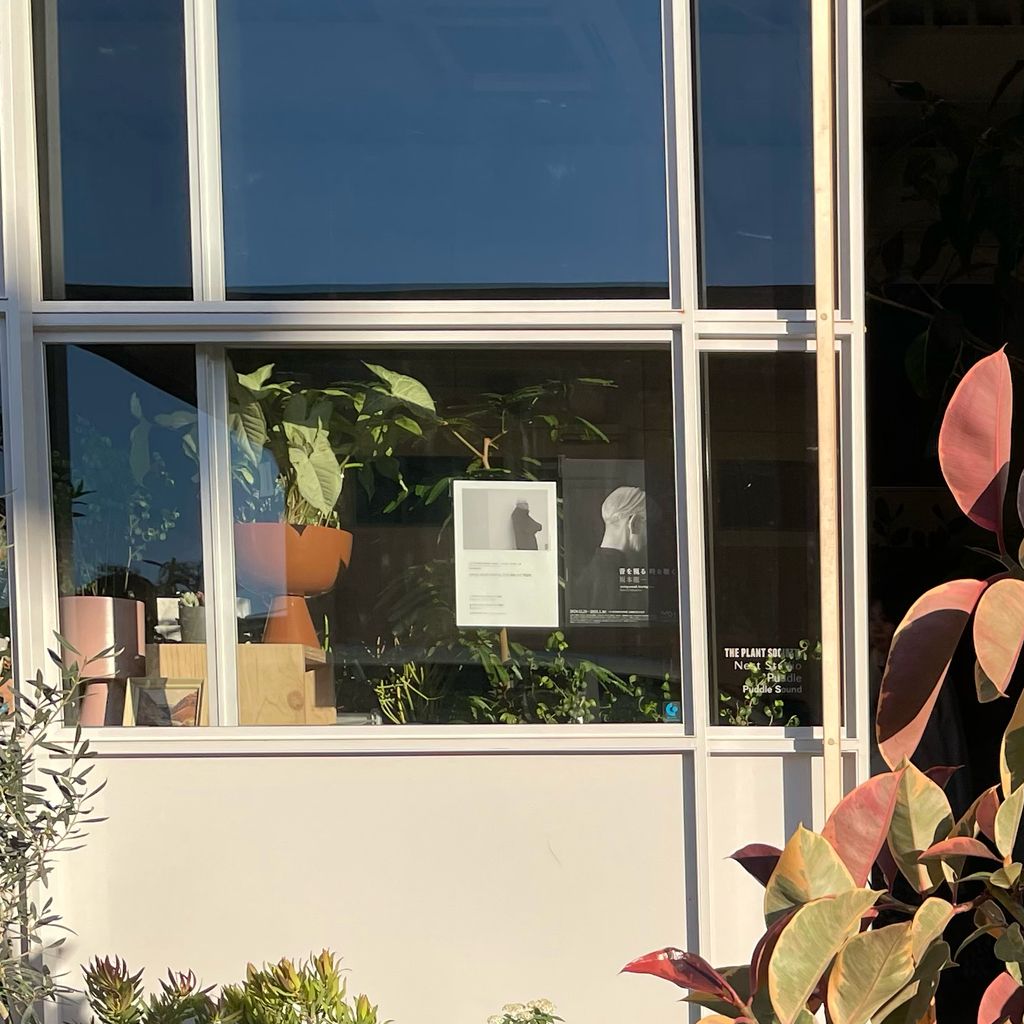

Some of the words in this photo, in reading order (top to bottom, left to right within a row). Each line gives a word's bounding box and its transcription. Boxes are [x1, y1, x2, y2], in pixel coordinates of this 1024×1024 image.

[724, 648, 739, 658] THE
[741, 648, 766, 658] PLANT
[734, 660, 761, 671] Net
[742, 684, 773, 694] Puddle
[774, 684, 803, 694] Sound
